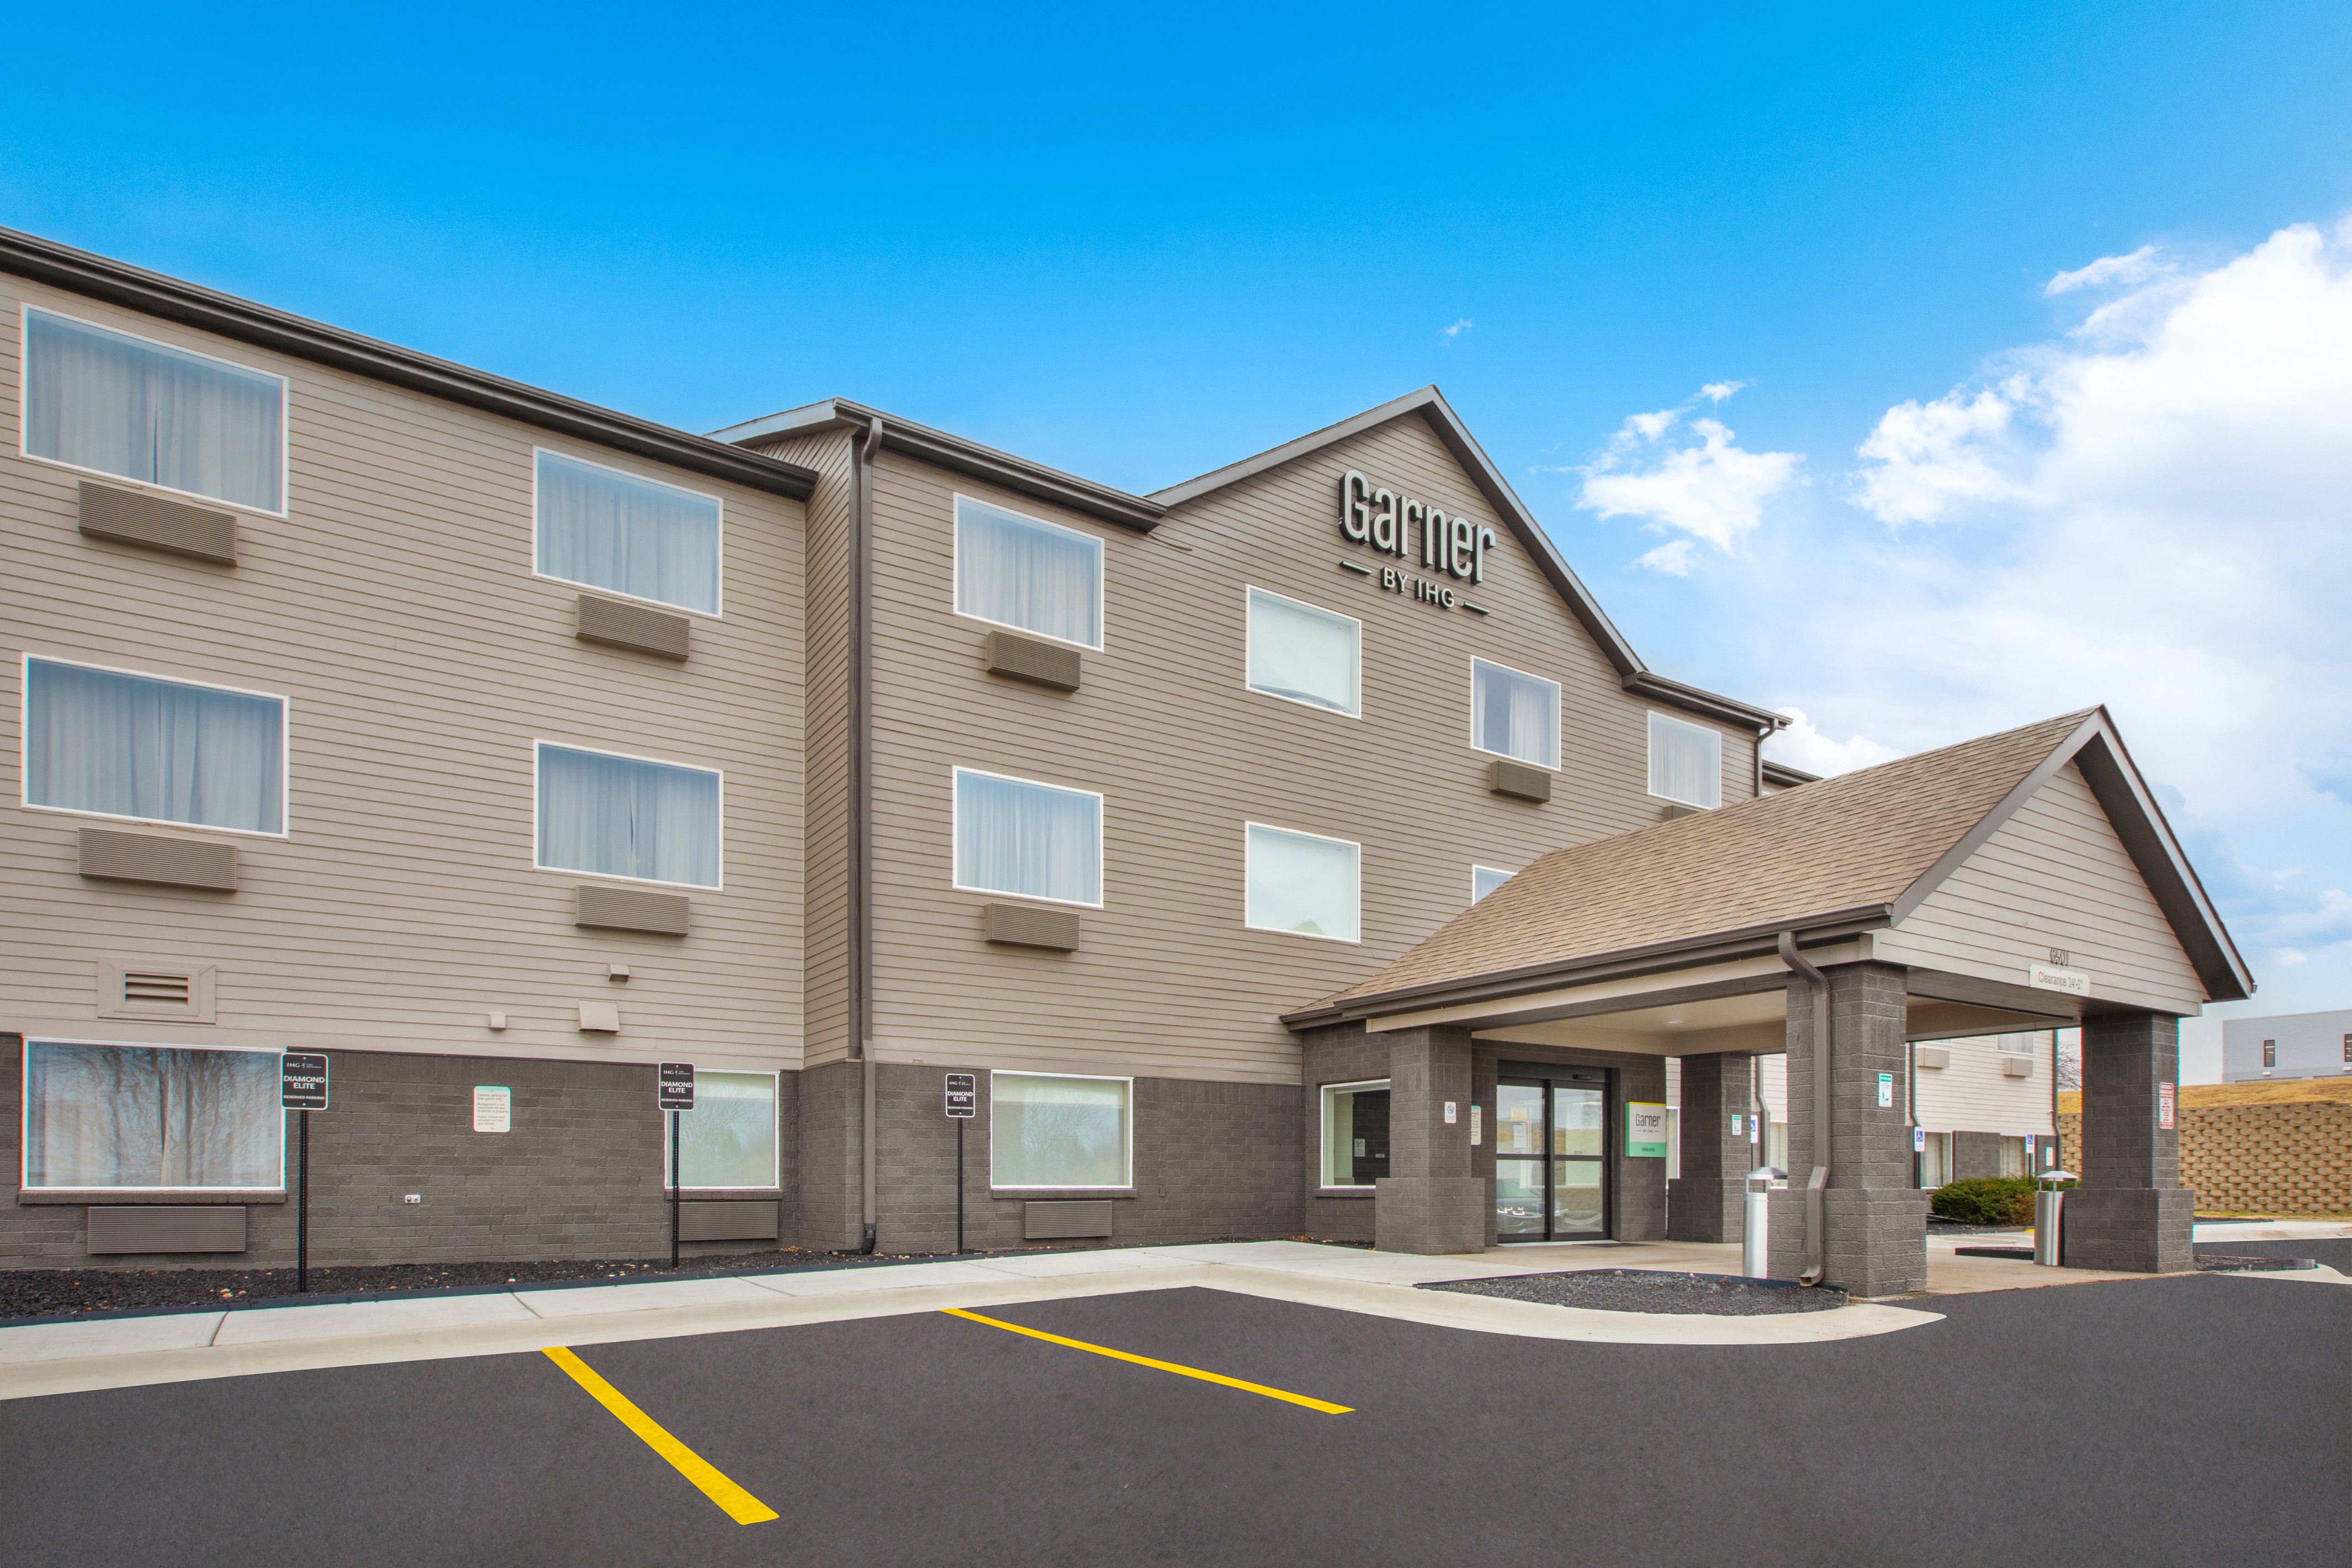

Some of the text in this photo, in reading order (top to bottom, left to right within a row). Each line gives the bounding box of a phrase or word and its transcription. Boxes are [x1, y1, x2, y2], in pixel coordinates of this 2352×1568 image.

[1338, 469, 1496, 585] Garner
[1380, 566, 1455, 609] BY IHG
[2051, 947, 2070, 966] 6501
[2038, 971, 2067, 987] Clearance
[1635, 1114, 1661, 1127] Garner
